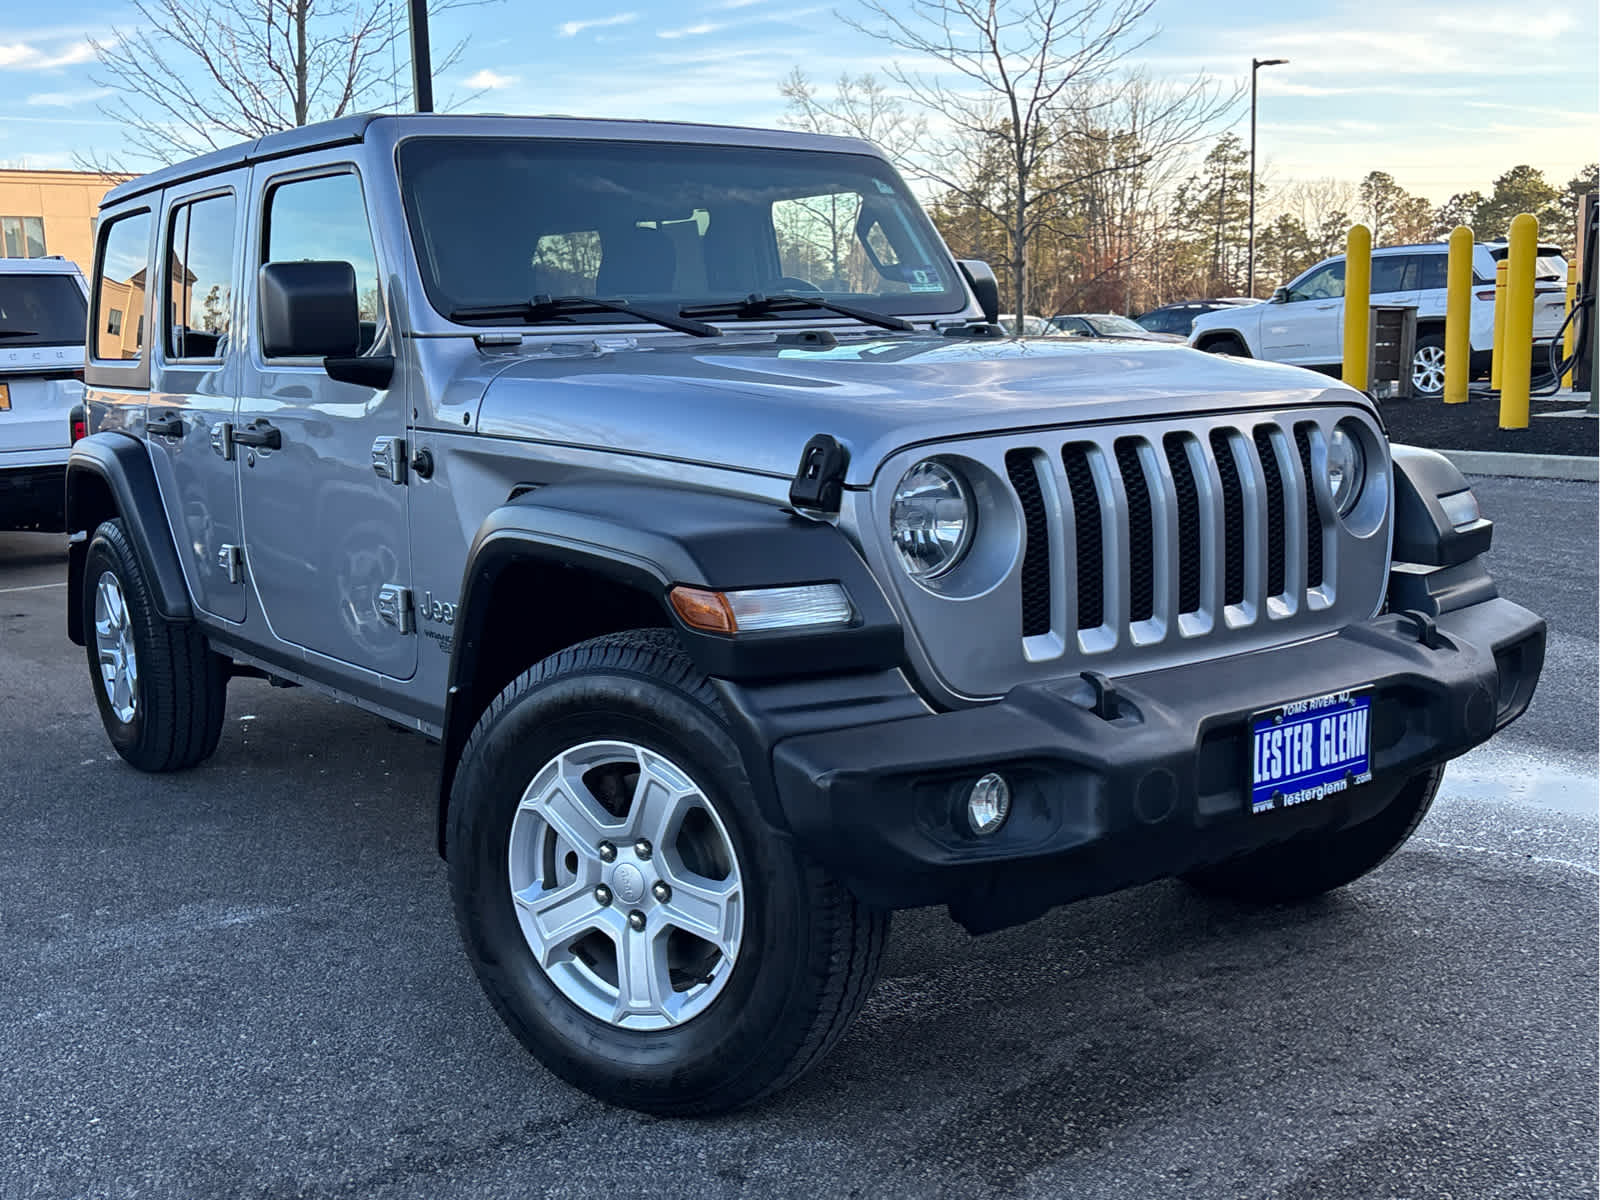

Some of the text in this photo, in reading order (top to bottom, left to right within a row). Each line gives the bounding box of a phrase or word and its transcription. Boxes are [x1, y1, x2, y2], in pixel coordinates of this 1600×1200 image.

[1282, 703, 1307, 717] TOMS
[1253, 708, 1368, 784] LESTER GLENN
[1283, 779, 1348, 807] lesterglenn
